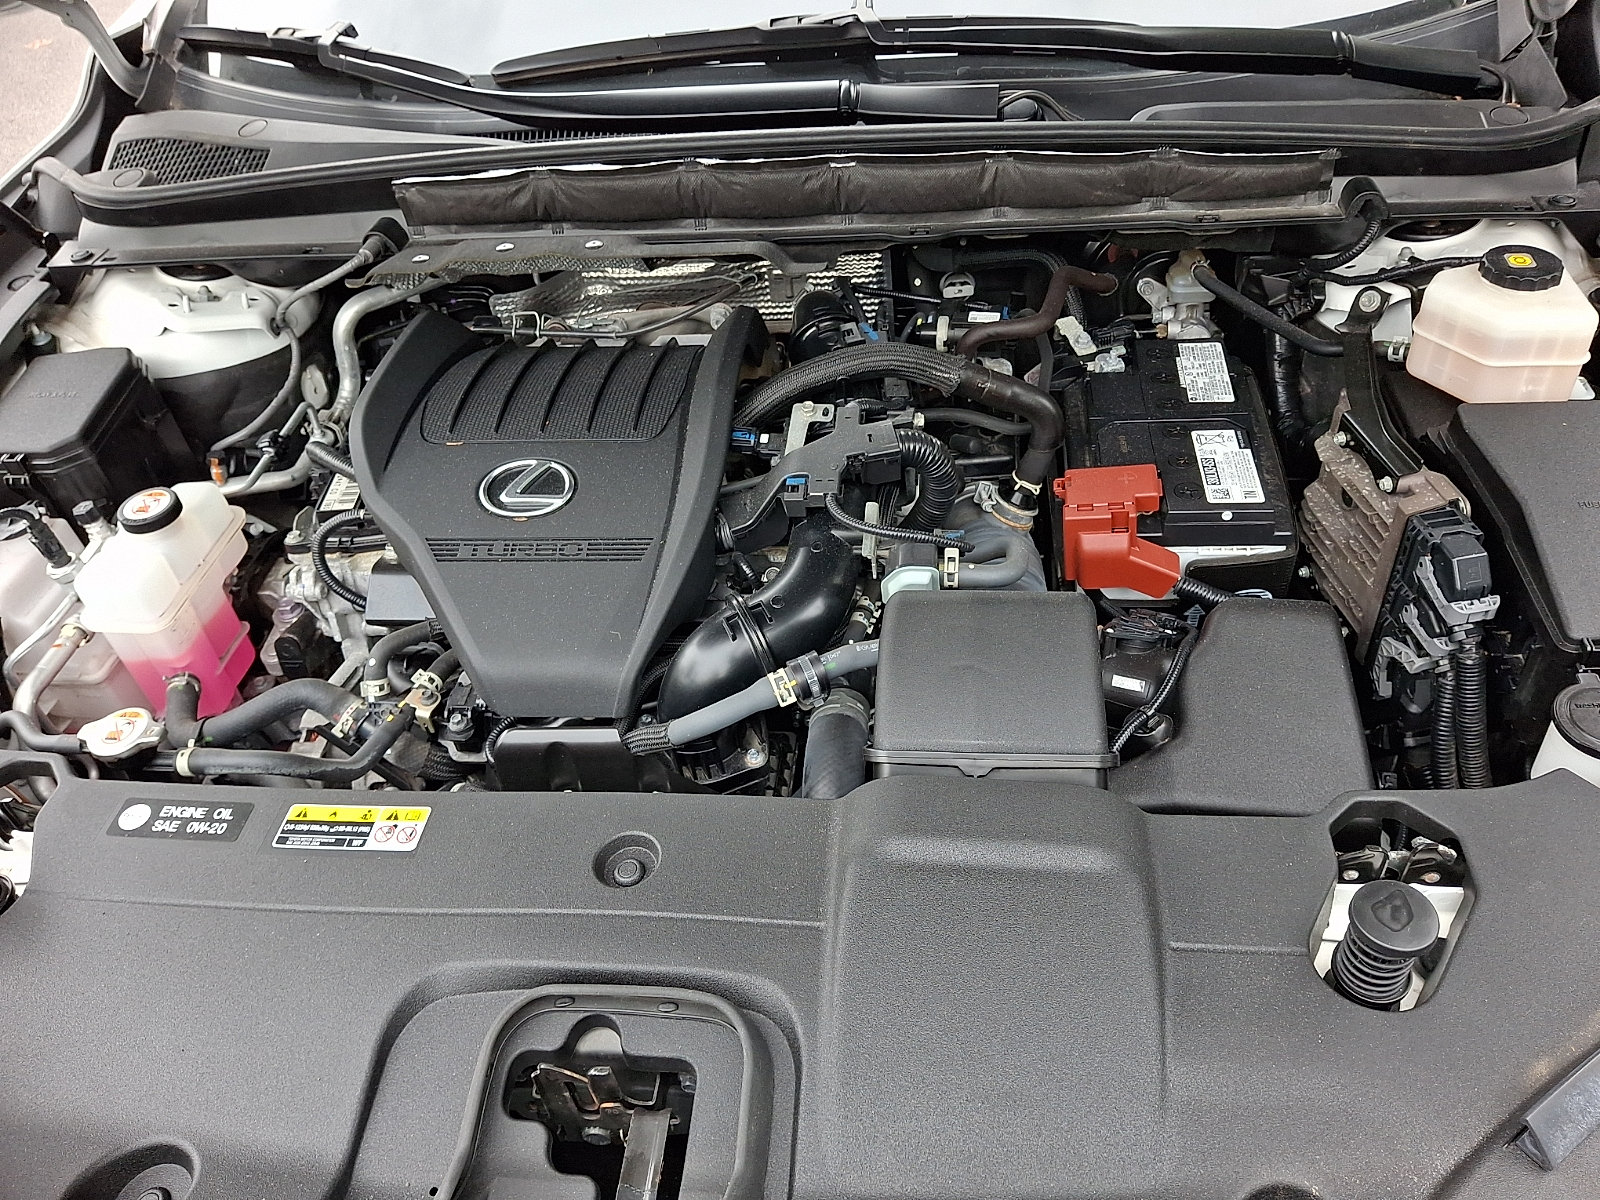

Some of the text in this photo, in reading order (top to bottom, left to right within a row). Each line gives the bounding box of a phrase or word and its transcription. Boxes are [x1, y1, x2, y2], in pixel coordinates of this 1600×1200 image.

[463, 542, 584, 557] TURBO
[159, 805, 209, 819] ENGINE
[212, 807, 234, 820] OIL
[151, 820, 228, 835] SAE 0W-20
